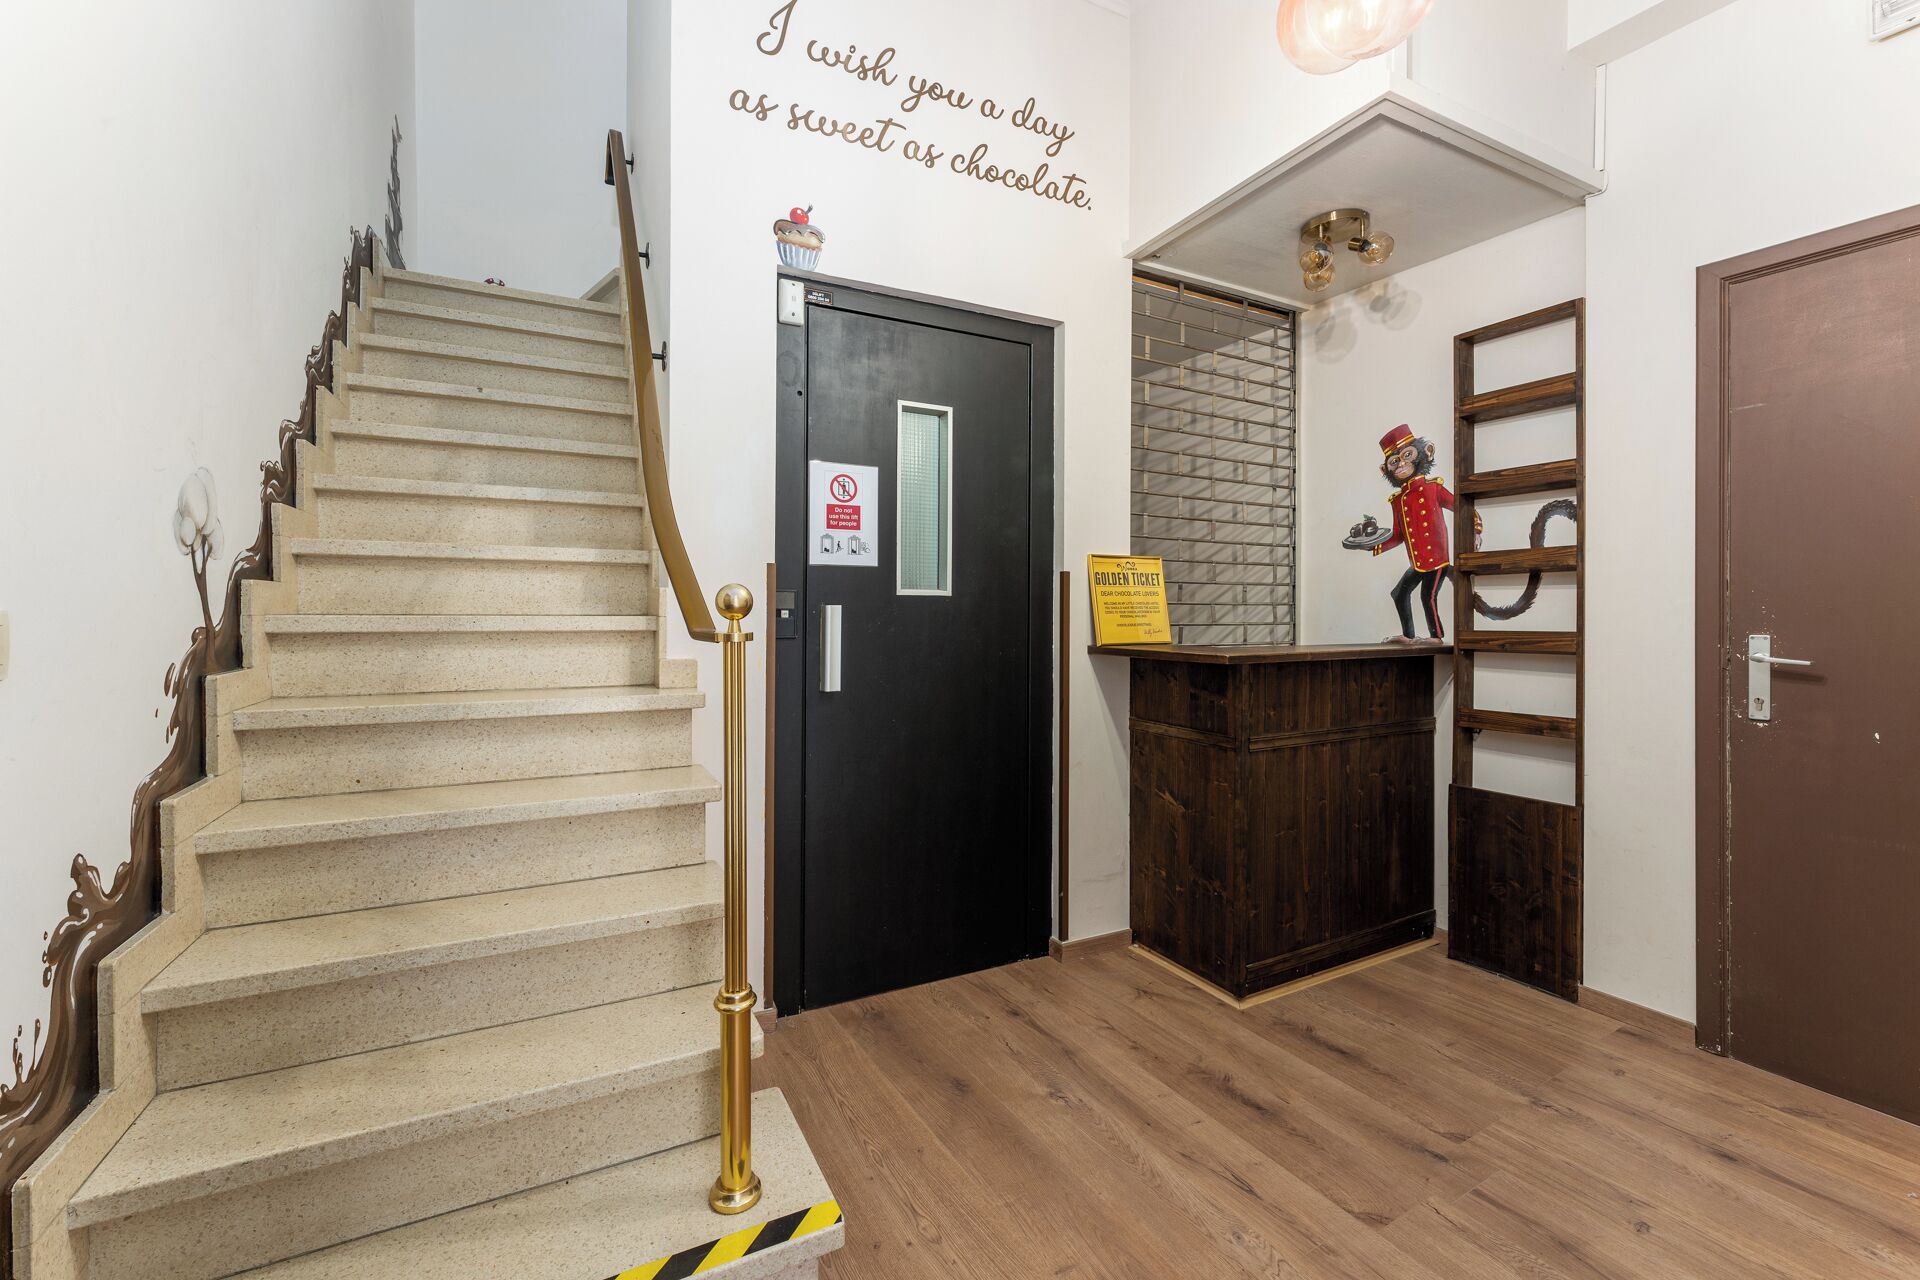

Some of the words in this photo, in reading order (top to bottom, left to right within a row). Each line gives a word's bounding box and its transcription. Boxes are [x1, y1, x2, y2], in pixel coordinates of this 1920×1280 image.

[756, 0, 798, 56] I
[807, 39, 898, 87] wish
[900, 75, 973, 113] you
[980, 98, 1004, 120] a
[1011, 97, 1075, 157] day
[729, 89, 779, 121] as
[787, 102, 907, 152] sweet
[903, 136, 944, 168] as
[950, 143, 1093, 211] chocolate.
[1095, 571, 1130, 586] GOLDEN
[1131, 572, 1160, 586] TICKET
